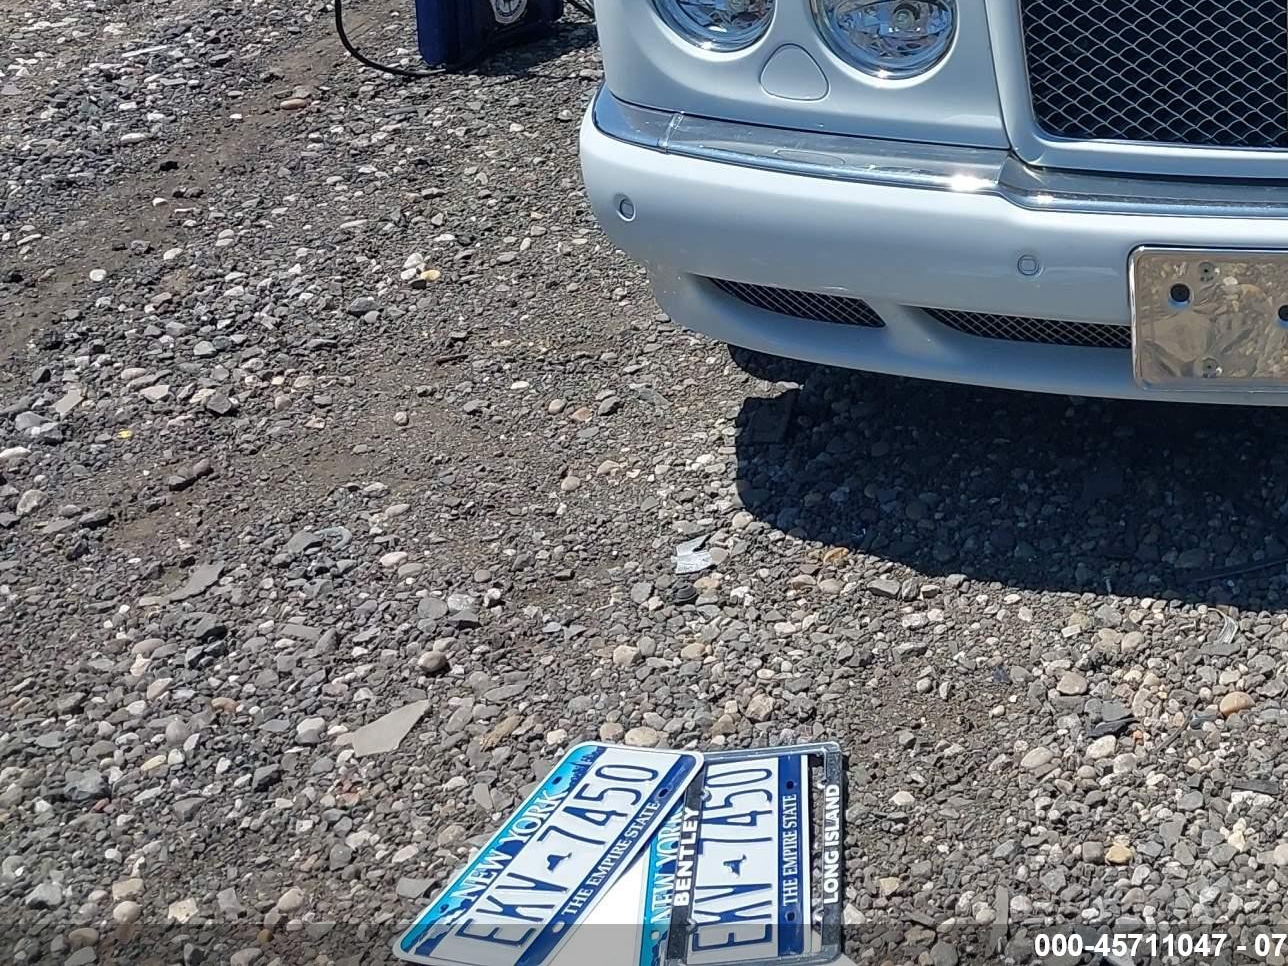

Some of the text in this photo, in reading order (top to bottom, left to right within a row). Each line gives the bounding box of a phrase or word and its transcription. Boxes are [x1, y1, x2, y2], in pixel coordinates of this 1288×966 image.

[451, 790, 568, 902] NEW YORK
[455, 764, 659, 947] EKV 7450
[562, 801, 661, 916] THE EMPIRE STATE
[673, 806, 699, 907] BENTLEY
[691, 769, 773, 952] EKV 7450
[782, 794, 798, 906] THE EMPIRE STATE
[823, 784, 840, 904] LONG ISLAND
